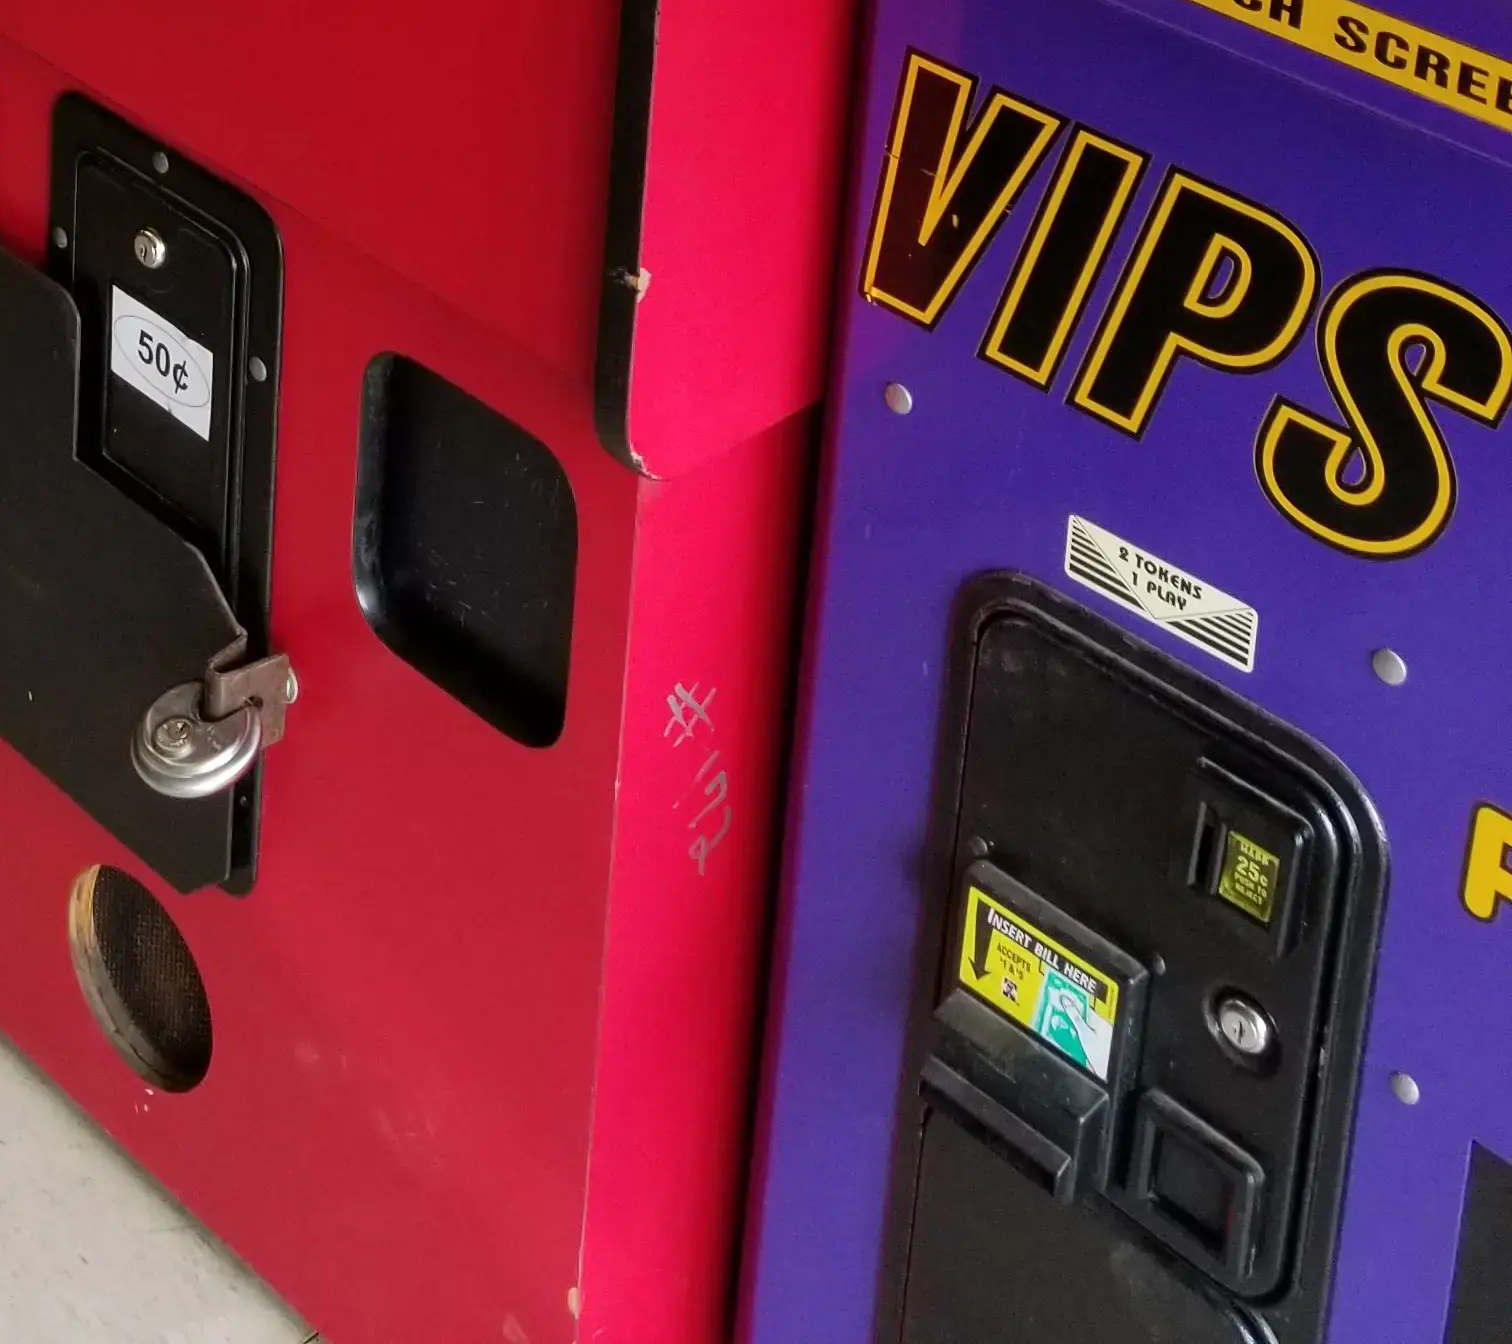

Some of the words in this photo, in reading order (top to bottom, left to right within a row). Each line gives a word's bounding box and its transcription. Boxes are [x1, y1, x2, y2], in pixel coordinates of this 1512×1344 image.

[858, 46, 1512, 562] VIPS
[136, 328, 190, 394] 50¢
[1118, 546, 1129, 562] 2
[1134, 552, 1202, 600] TOKENS
[1132, 571, 1138, 586] 1
[1146, 580, 1187, 611] PLAY
[987, 907, 1033, 948] INSERT
[1034, 941, 1060, 970] BILL
[1063, 961, 1098, 994] HERE
[996, 942, 1031, 973] ACCEPTS
